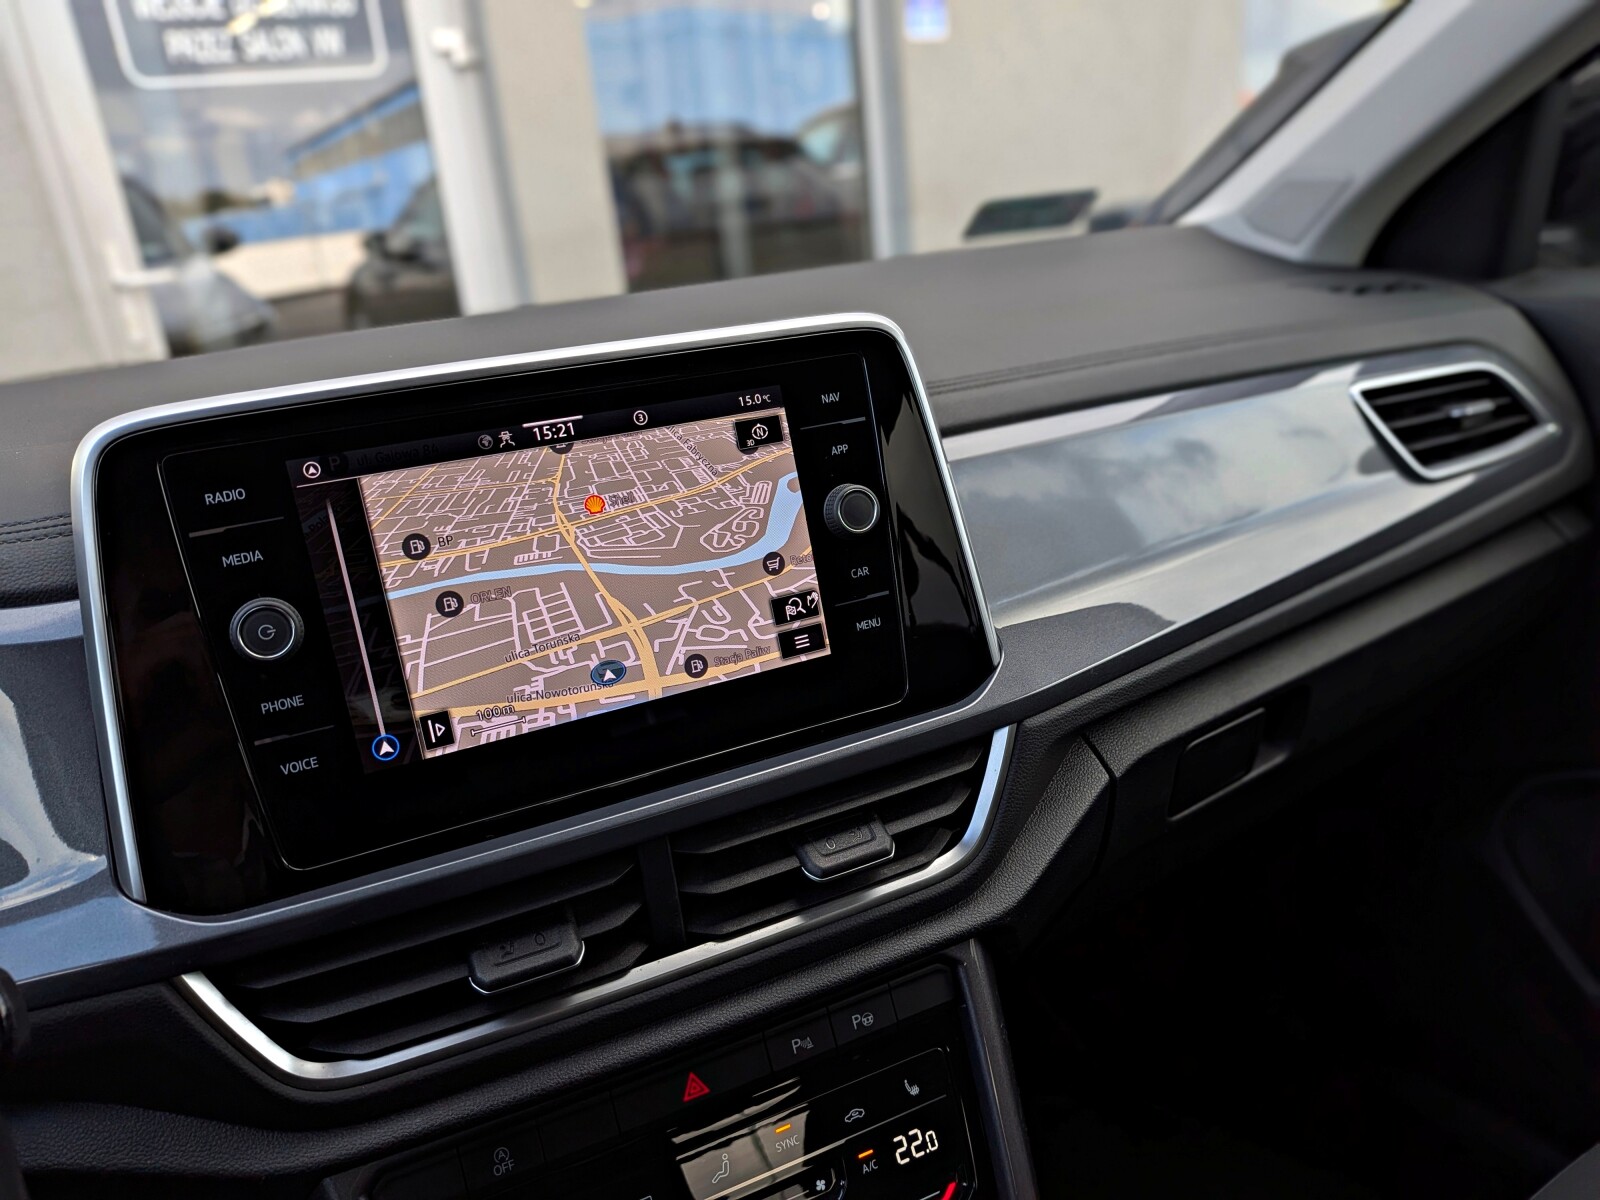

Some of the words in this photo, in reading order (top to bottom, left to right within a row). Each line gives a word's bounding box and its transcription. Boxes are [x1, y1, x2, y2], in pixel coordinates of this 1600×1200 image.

[821, 392, 840, 404] NAV
[532, 421, 576, 441] 15:21
[682, 438, 718, 476] Fabryczna
[831, 444, 849, 456] APP
[204, 488, 247, 505] RADIO
[437, 535, 454, 548] BP
[222, 550, 264, 567] MEDIA
[851, 566, 869, 578] CAR
[470, 586, 513, 605] ORLEN
[856, 616, 881, 632] MENU
[504, 647, 530, 664] ulica
[532, 632, 581, 656] Toruńska
[714, 653, 743, 668] Stacja
[745, 645, 771, 660] Paliw
[260, 694, 305, 715] PHONE
[506, 690, 533, 704] ulica
[279, 756, 319, 775] VOICE
[775, 1134, 800, 1152] SYNC
[893, 1128, 939, 1165] 22.0
[493, 1159, 515, 1176] OFF
[862, 1159, 879, 1174] A/C
